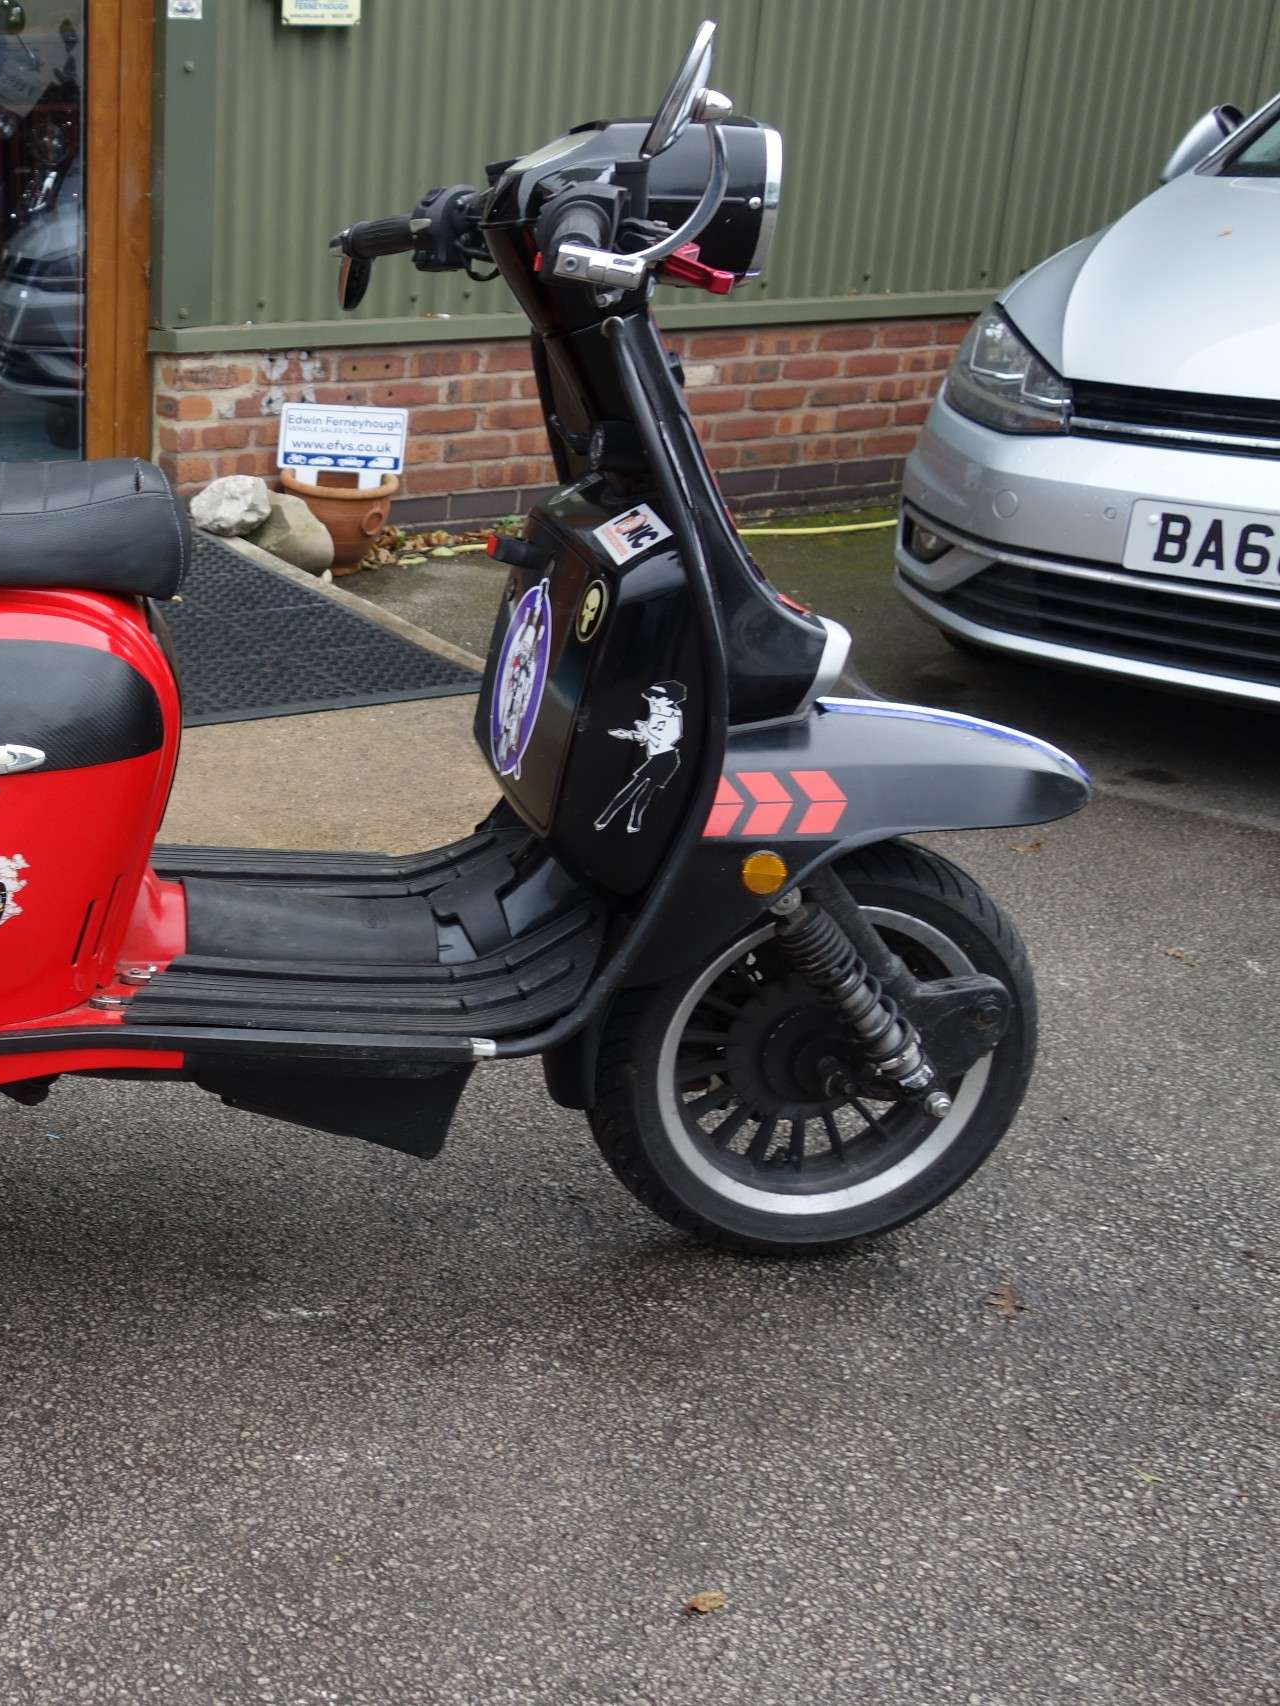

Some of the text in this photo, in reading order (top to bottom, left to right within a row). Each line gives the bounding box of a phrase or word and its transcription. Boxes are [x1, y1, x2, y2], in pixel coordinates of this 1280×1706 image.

[288, 414, 401, 431] Edwin Ferneyhough
[292, 439, 392, 453] www.efvs.co.uk
[1152, 512, 1280, 576] BA6
